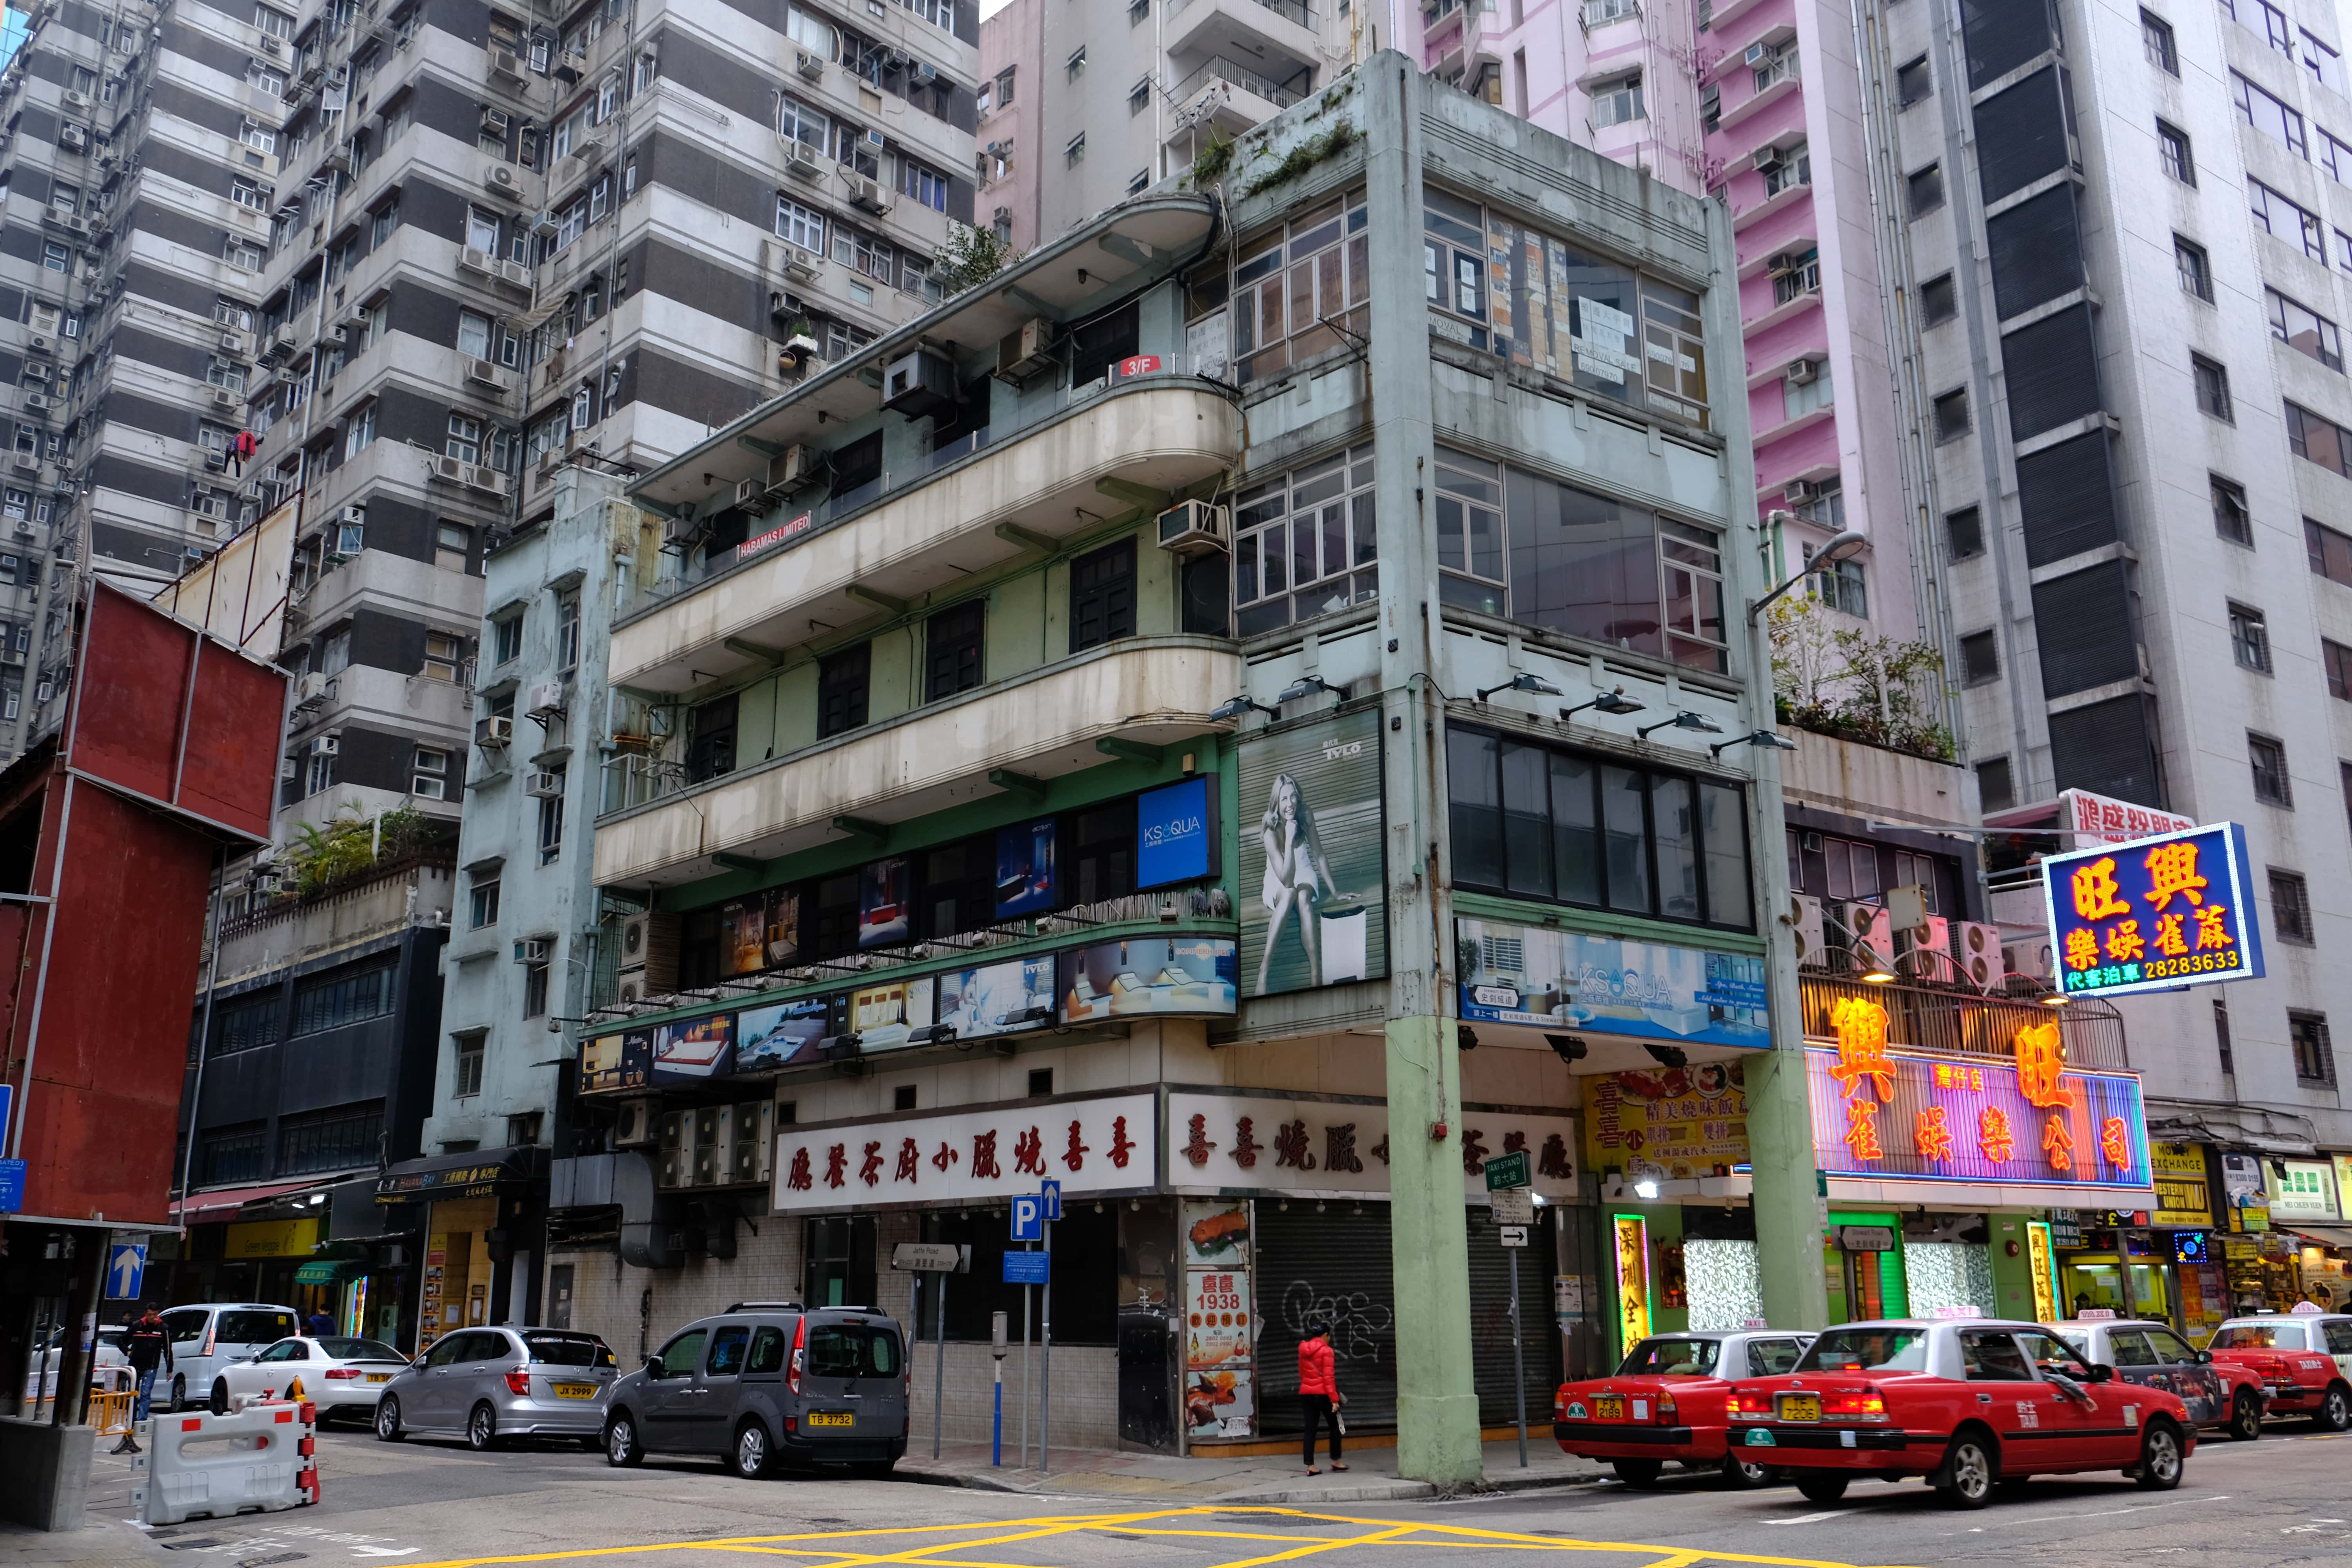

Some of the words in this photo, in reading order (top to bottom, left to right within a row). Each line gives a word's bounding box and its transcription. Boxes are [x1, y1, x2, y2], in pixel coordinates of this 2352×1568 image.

[1573, 343, 1613, 363] REMOVAL
[1615, 358, 1637, 371] SALE
[1128, 358, 1151, 376] 3/F
[1189, 354, 1227, 376] RMOVAL
[740, 530, 777, 557] HABAMAS
[779, 515, 808, 540] LIMITED
[2066, 964, 2140, 990] 代客泊車
[2144, 950, 2238, 978] 28283633
[1481, 993, 1513, 1005] 史釗域道
[1936, 1063, 1984, 1091] 灣仔店
[1645, 1097, 1749, 1122] 精美燒味飯盒
[1646, 1125, 1670, 1145] 單拼
[1703, 1121, 1728, 1141] 雙拼
[2158, 1146, 2190, 1156] MOY
[1487, 1162, 1499, 1173] TAXI
[1500, 1157, 1521, 1169] STAND
[2151, 1159, 2201, 1170] EXCHANGE
[1494, 1169, 1517, 1186] 的士站
[2163, 1196, 2185, 1209] UNION
[1016, 1200, 1036, 1236] P
[2134, 1212, 2147, 1225] RMB
[245, 1239, 261, 1253] Green
[261, 1239, 279, 1255] Veggie
[915, 1258, 935, 1267] 謝斐道
[1202, 1274, 1234, 1293] 喜喜
[1197, 1294, 1240, 1310] 1938
[1937, 1307, 1972, 1316] TAXI
[1191, 1314, 1246, 1326] 歡迎預訂
[1603, 1399, 1615, 1408] FG
[1793, 1397, 1807, 1408] TF
[2016, 1400, 2036, 1414] 的士
[811, 1416, 823, 1424] TB
[827, 1416, 850, 1424] 3732
[1599, 1408, 1620, 1417] 2189
[2018, 1414, 2039, 1428] TAXI
